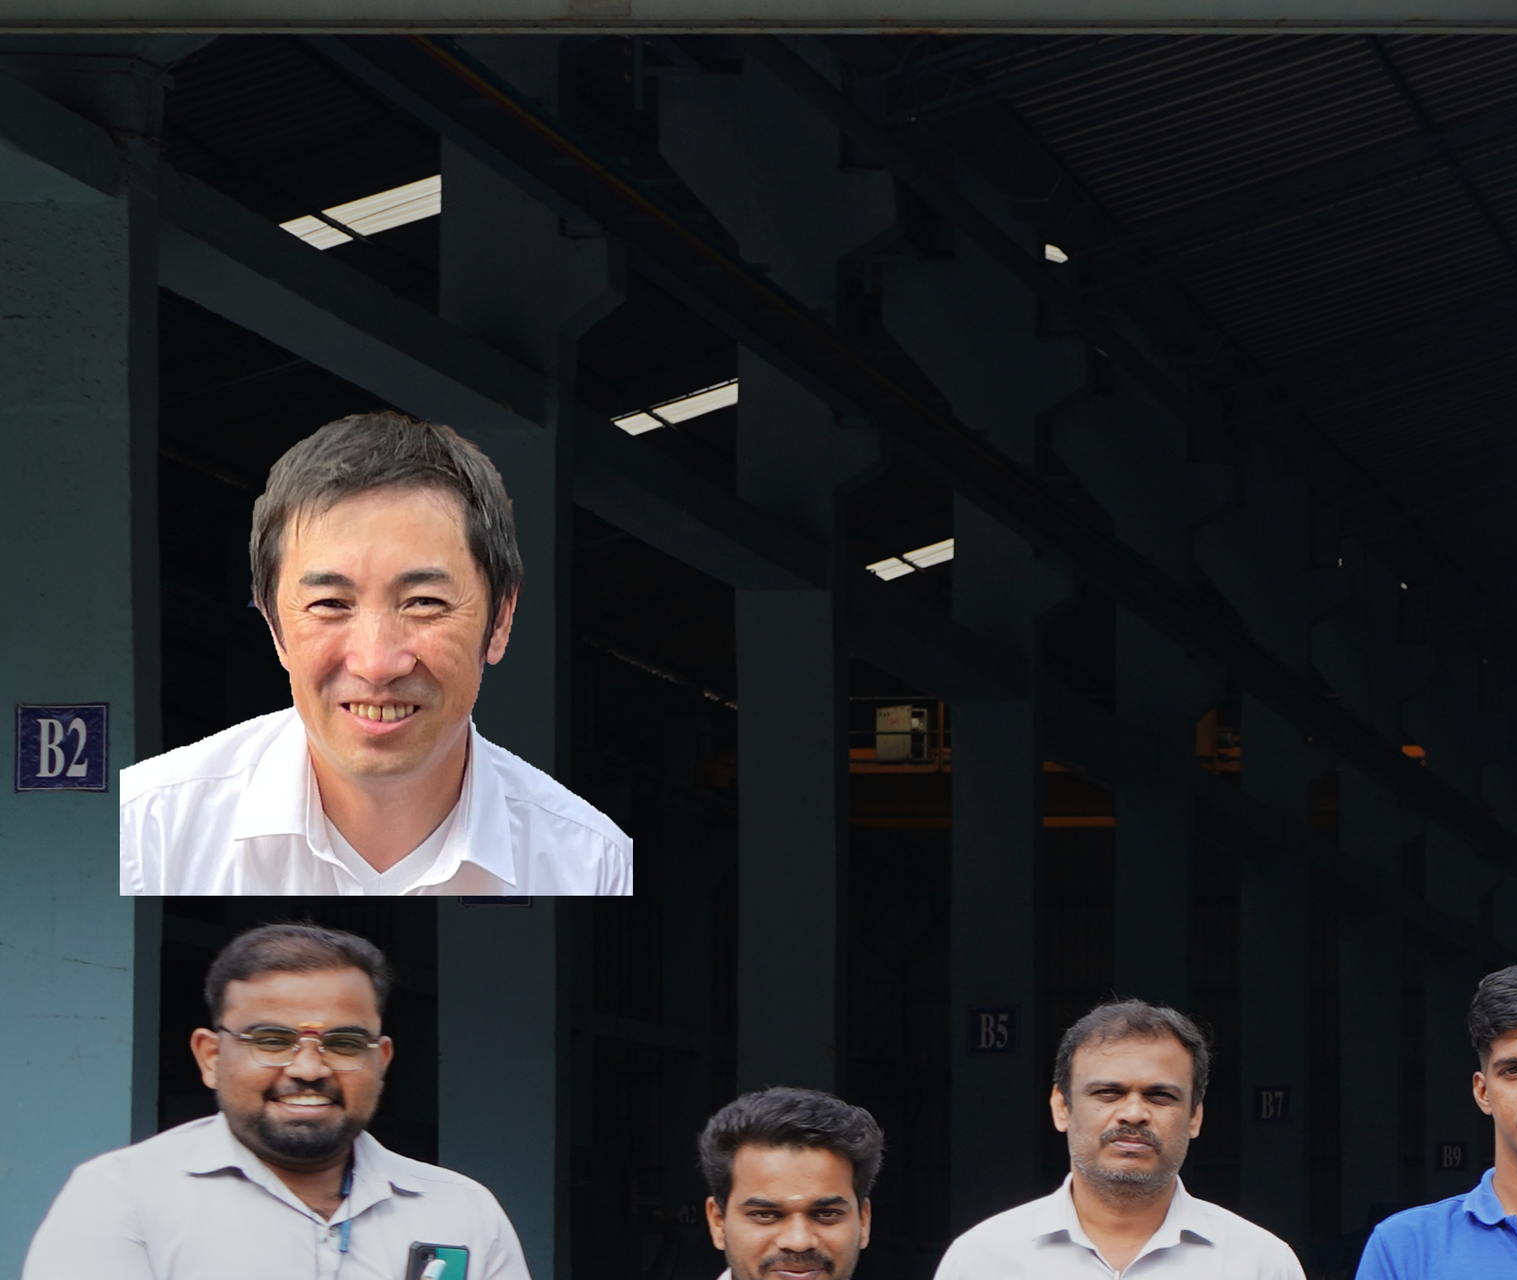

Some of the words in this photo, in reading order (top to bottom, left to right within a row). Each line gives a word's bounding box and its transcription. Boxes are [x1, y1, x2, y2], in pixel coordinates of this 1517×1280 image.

[37, 717, 89, 778] B2
[979, 1014, 1009, 1050] B5
[1261, 1091, 1284, 1119] B7
[1442, 1146, 1462, 1169] B9
